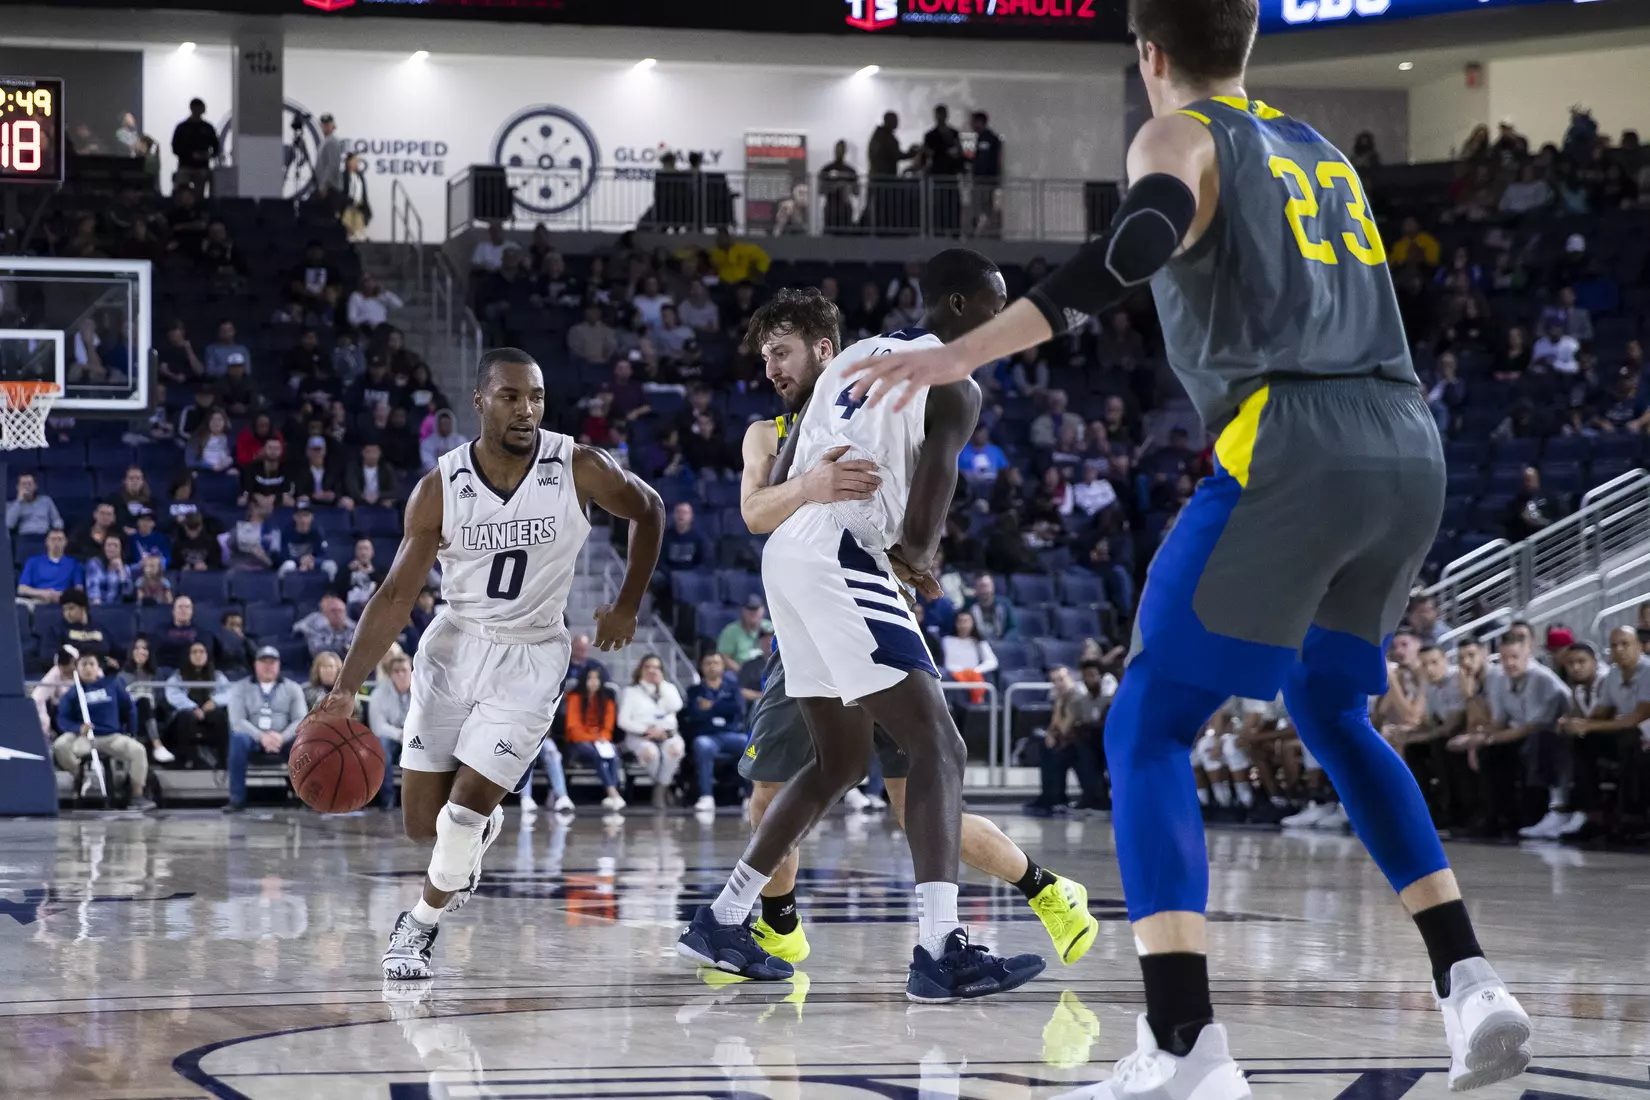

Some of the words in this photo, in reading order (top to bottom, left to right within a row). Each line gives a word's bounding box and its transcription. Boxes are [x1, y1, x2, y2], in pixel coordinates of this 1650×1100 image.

[1, 120, 41, 171] 18
[375, 159, 444, 175] SERVE
[1267, 154, 1386, 265] 23
[537, 476, 559, 486] WAC
[462, 516, 556, 550] LANCERS
[486, 549, 528, 600] 0
